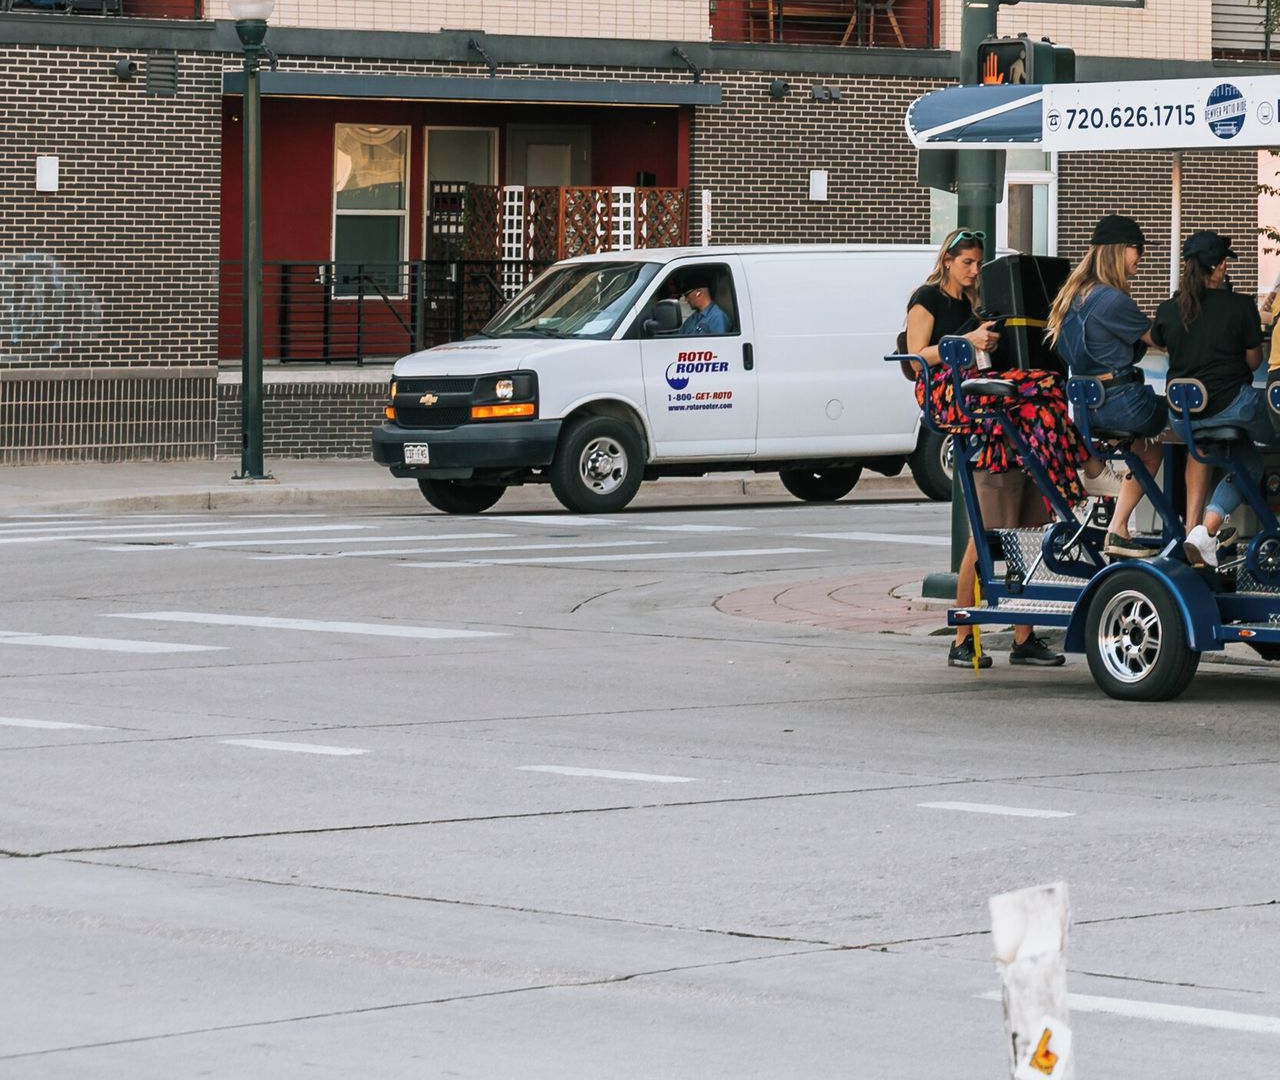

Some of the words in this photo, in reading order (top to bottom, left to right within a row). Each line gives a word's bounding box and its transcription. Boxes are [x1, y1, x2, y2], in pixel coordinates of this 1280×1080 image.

[1066, 104, 1196, 130] 720.626.1715
[677, 351, 718, 362] ROTO-
[676, 362, 729, 373] ROOTER
[668, 403, 733, 411] www.rotorooter.com
